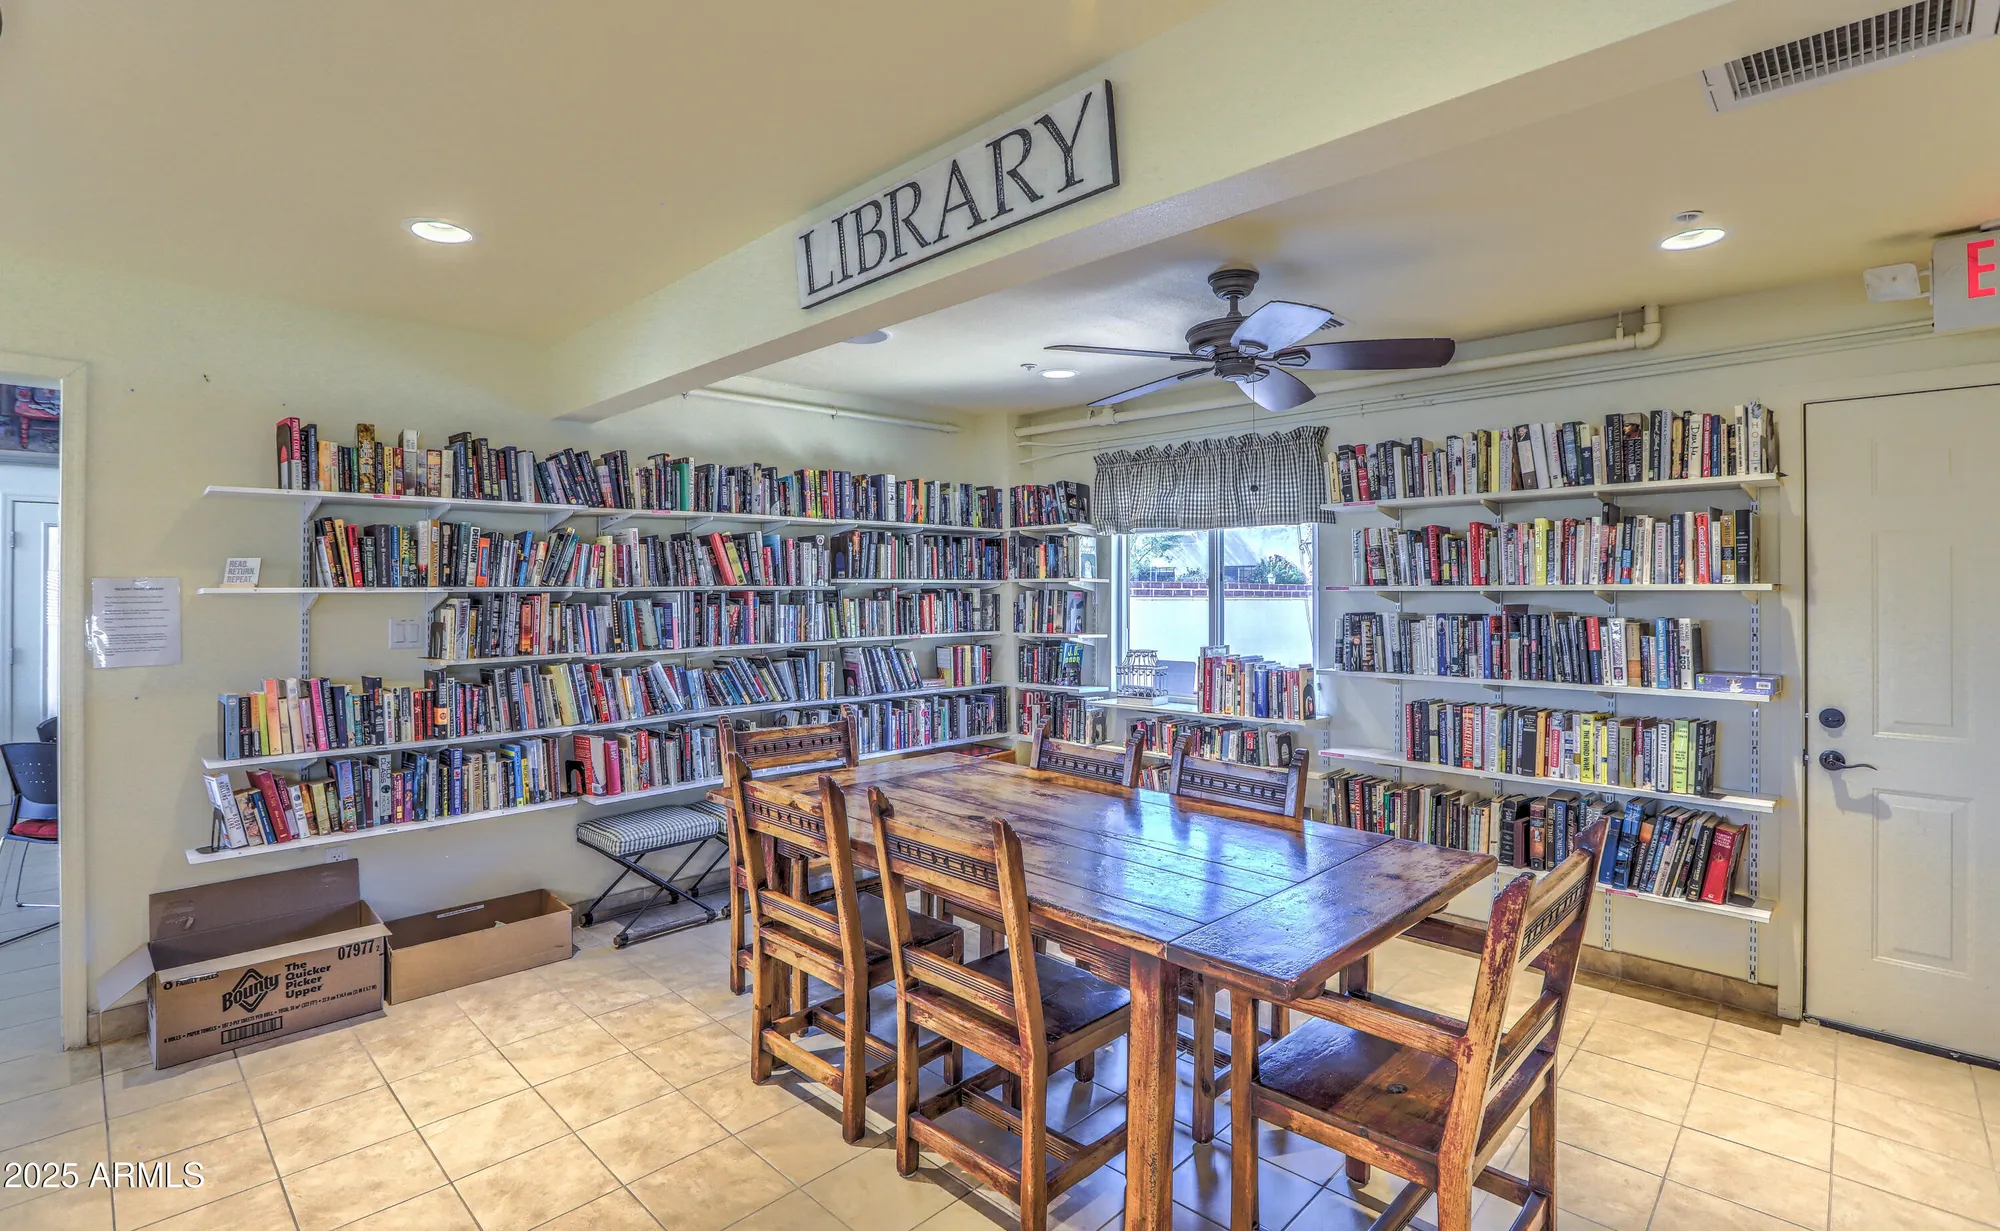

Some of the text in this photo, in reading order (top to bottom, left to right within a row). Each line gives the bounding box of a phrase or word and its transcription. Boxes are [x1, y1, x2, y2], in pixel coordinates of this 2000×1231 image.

[798, 92, 1092, 296] LIBRARY
[1690, 424, 1700, 446] Dear
[470, 528, 479, 563] DEIGHTON
[1464, 719, 1473, 755] BASKETBALL
[1608, 720, 1616, 756] GETTYSBURG
[220, 782, 228, 801] ROLLINS
[232, 813, 241, 830] BLOOD
[1693, 830, 1710, 881] Contemporary Astronomy
[338, 940, 374, 960] 07977
[285, 962, 307, 972] The
[285, 965, 331, 980] Quicker
[222, 973, 281, 1012] Bounty
[286, 976, 322, 990] Picker
[286, 984, 323, 999] Upper
